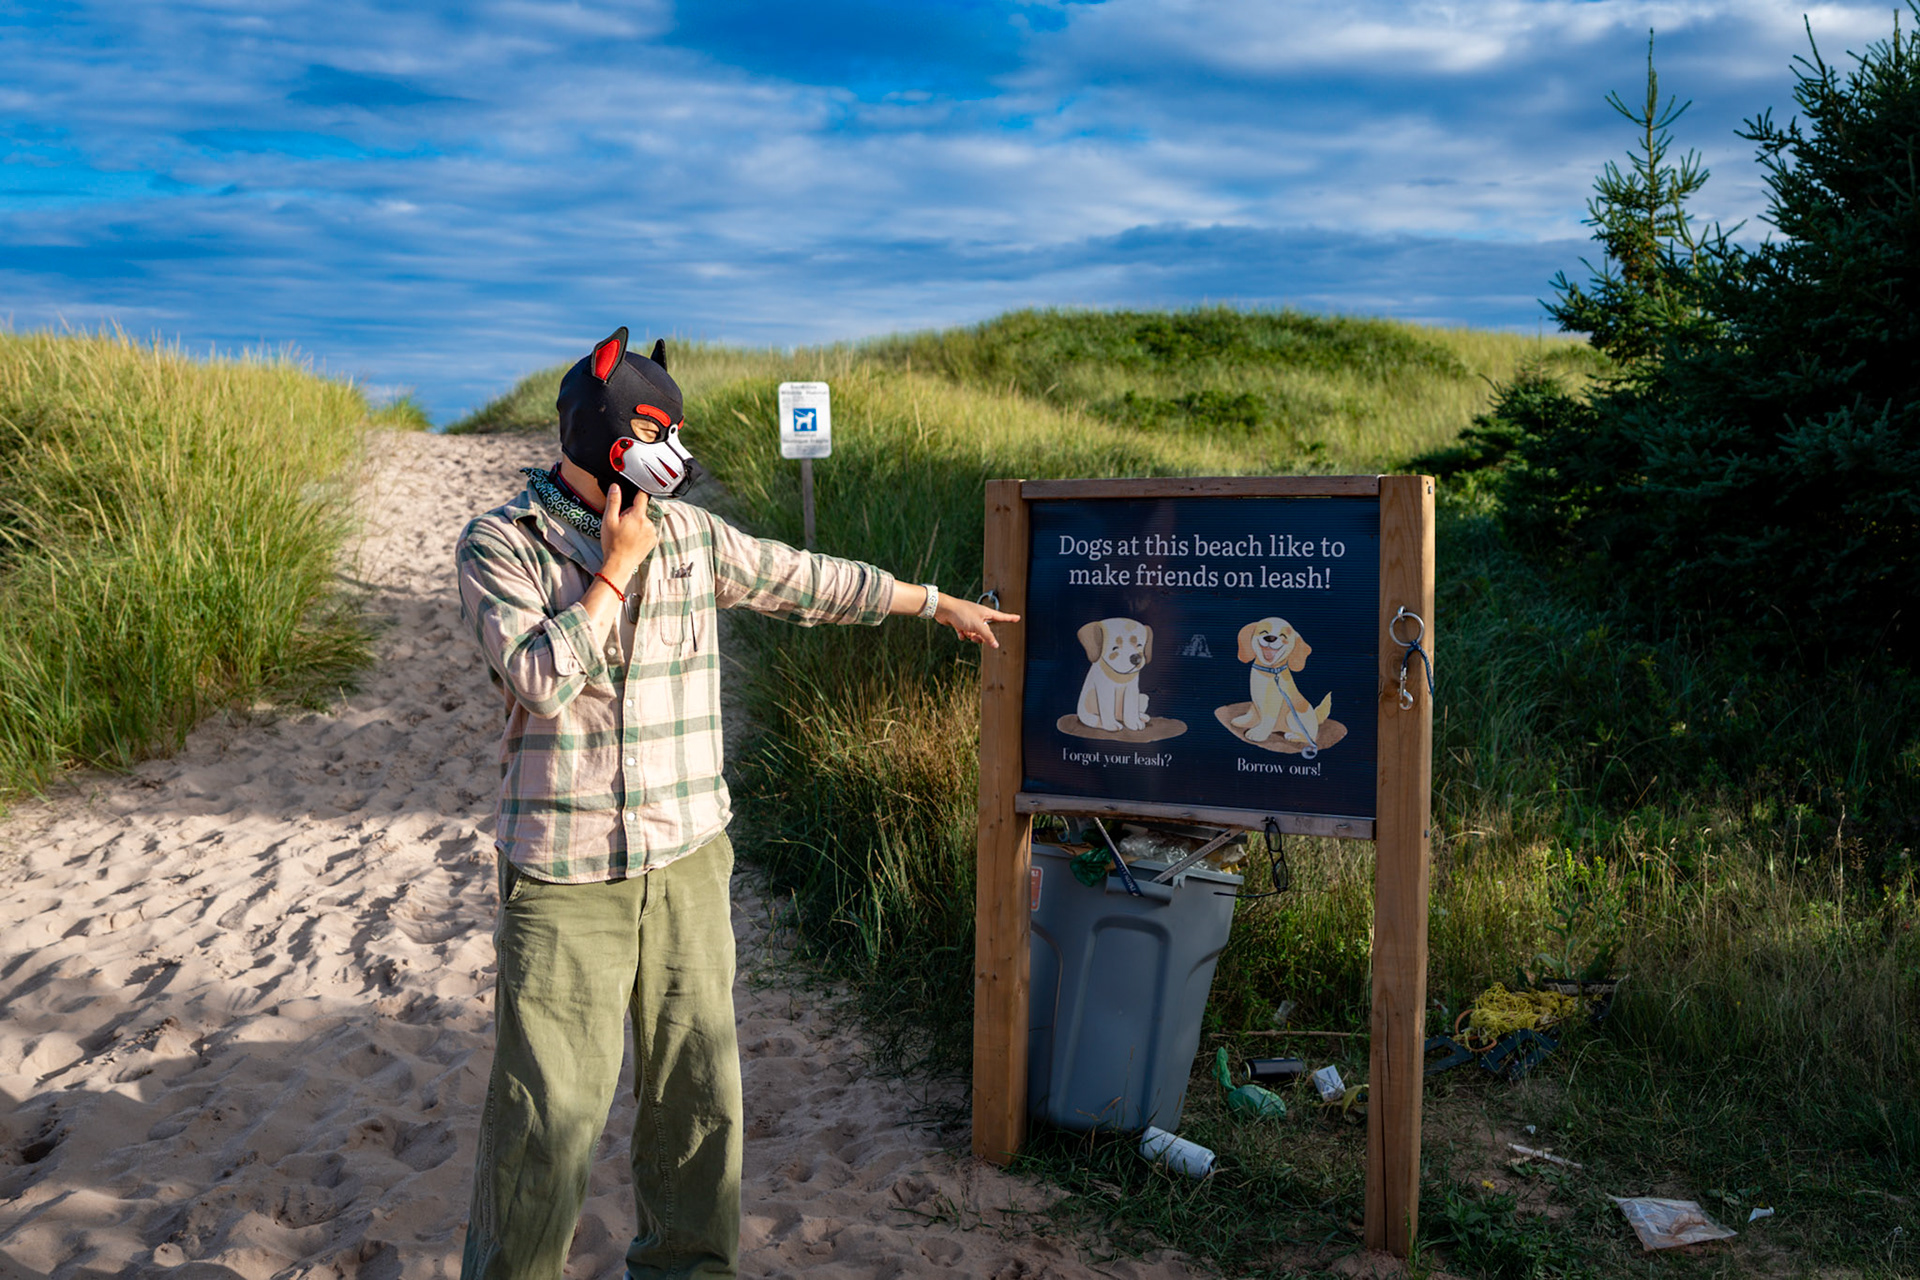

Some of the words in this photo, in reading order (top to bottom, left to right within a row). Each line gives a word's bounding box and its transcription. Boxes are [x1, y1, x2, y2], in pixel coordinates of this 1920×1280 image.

[1059, 535, 1112, 560] Dogs
[1118, 538, 1139, 556] at
[1146, 534, 1188, 556] this
[1194, 534, 1263, 556] beach
[1269, 534, 1314, 557] like
[1321, 538, 1345, 557] to
[1069, 564, 1130, 585] make
[1136, 564, 1219, 587] friends
[1224, 571, 1254, 588] on
[1260, 566, 1330, 589] leash!
[1103, 754, 1131, 767] your
[1134, 752, 1172, 767] leash?
[1238, 758, 1283, 773] Borrow
[1289, 762, 1320, 776] ours!
